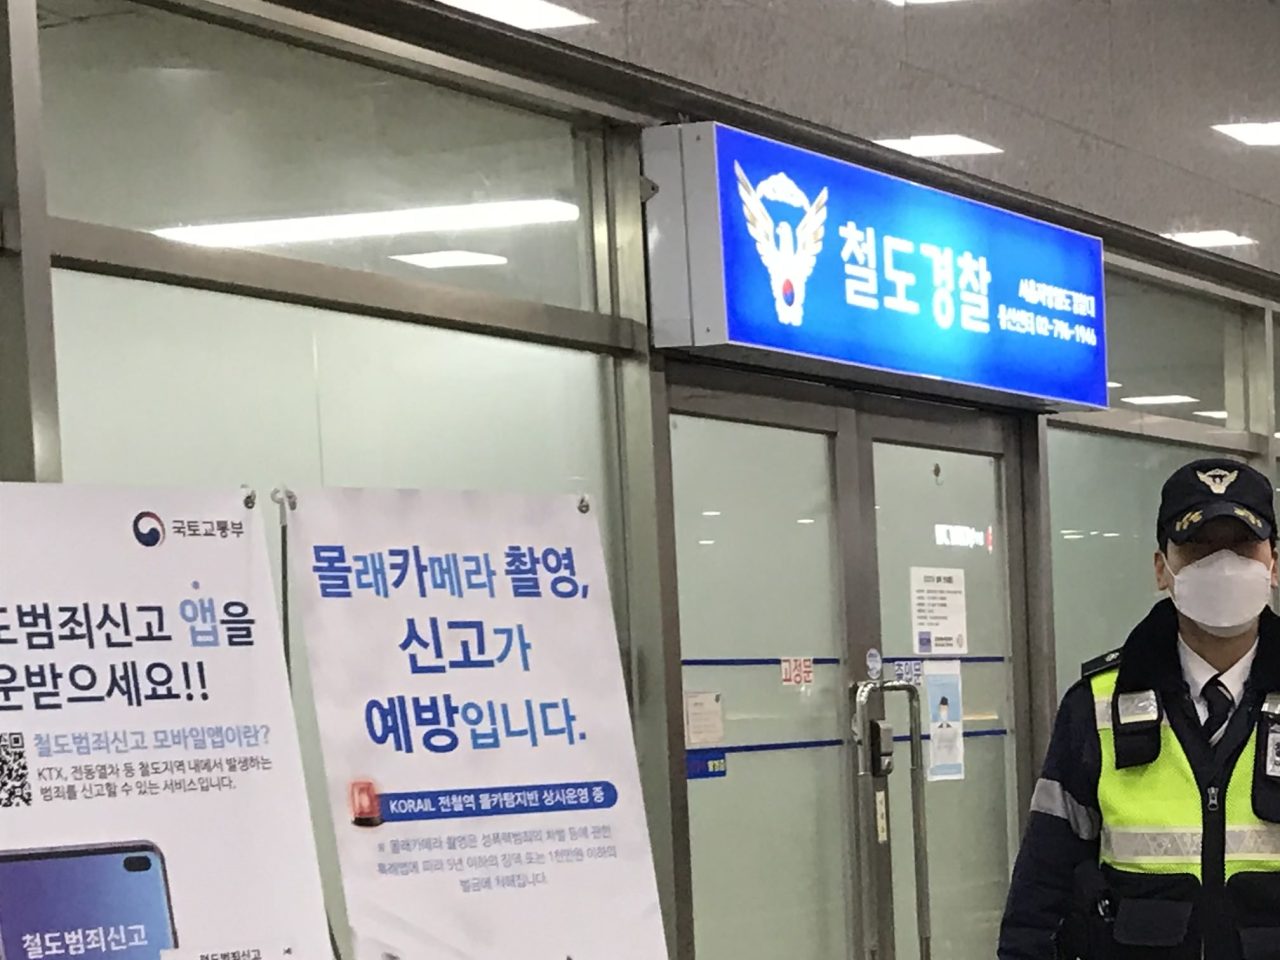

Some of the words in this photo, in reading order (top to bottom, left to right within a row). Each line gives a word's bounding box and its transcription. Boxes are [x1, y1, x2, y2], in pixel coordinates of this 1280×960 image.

[839, 221, 992, 334] 철도경찰
[172, 519, 244, 538] 국토교통부
[312, 545, 496, 598] 몰래카메라
[504, 545, 589, 599] 촬영,
[179, 598, 255, 648] 앱을
[399, 617, 532, 674] 신고가
[33, 729, 148, 757] 철도범죄신고
[153, 724, 270, 751] 모바일앱이란?
[365, 694, 586, 753] 예방입니다.
[38, 767, 68, 782] KTX,
[71, 763, 120, 781] 전동열차
[124, 762, 135, 778] 등
[139, 759, 185, 777] 철도지역
[226, 755, 272, 771] 발생하는
[40, 784, 78, 801] 범죄를
[80, 782, 117, 799] 신고할
[121, 782, 133, 796] 수
[136, 780, 160, 796] 있는
[163, 777, 237, 794] 서비스입니다.
[389, 799, 436, 815] KORAIL
[438, 794, 475, 812] 전철역
[479, 790, 540, 811] 몰카탐지반
[542, 786, 589, 807] 상시운영
[592, 786, 604, 803] 중
[22, 924, 148, 960] 철도범죄신고
